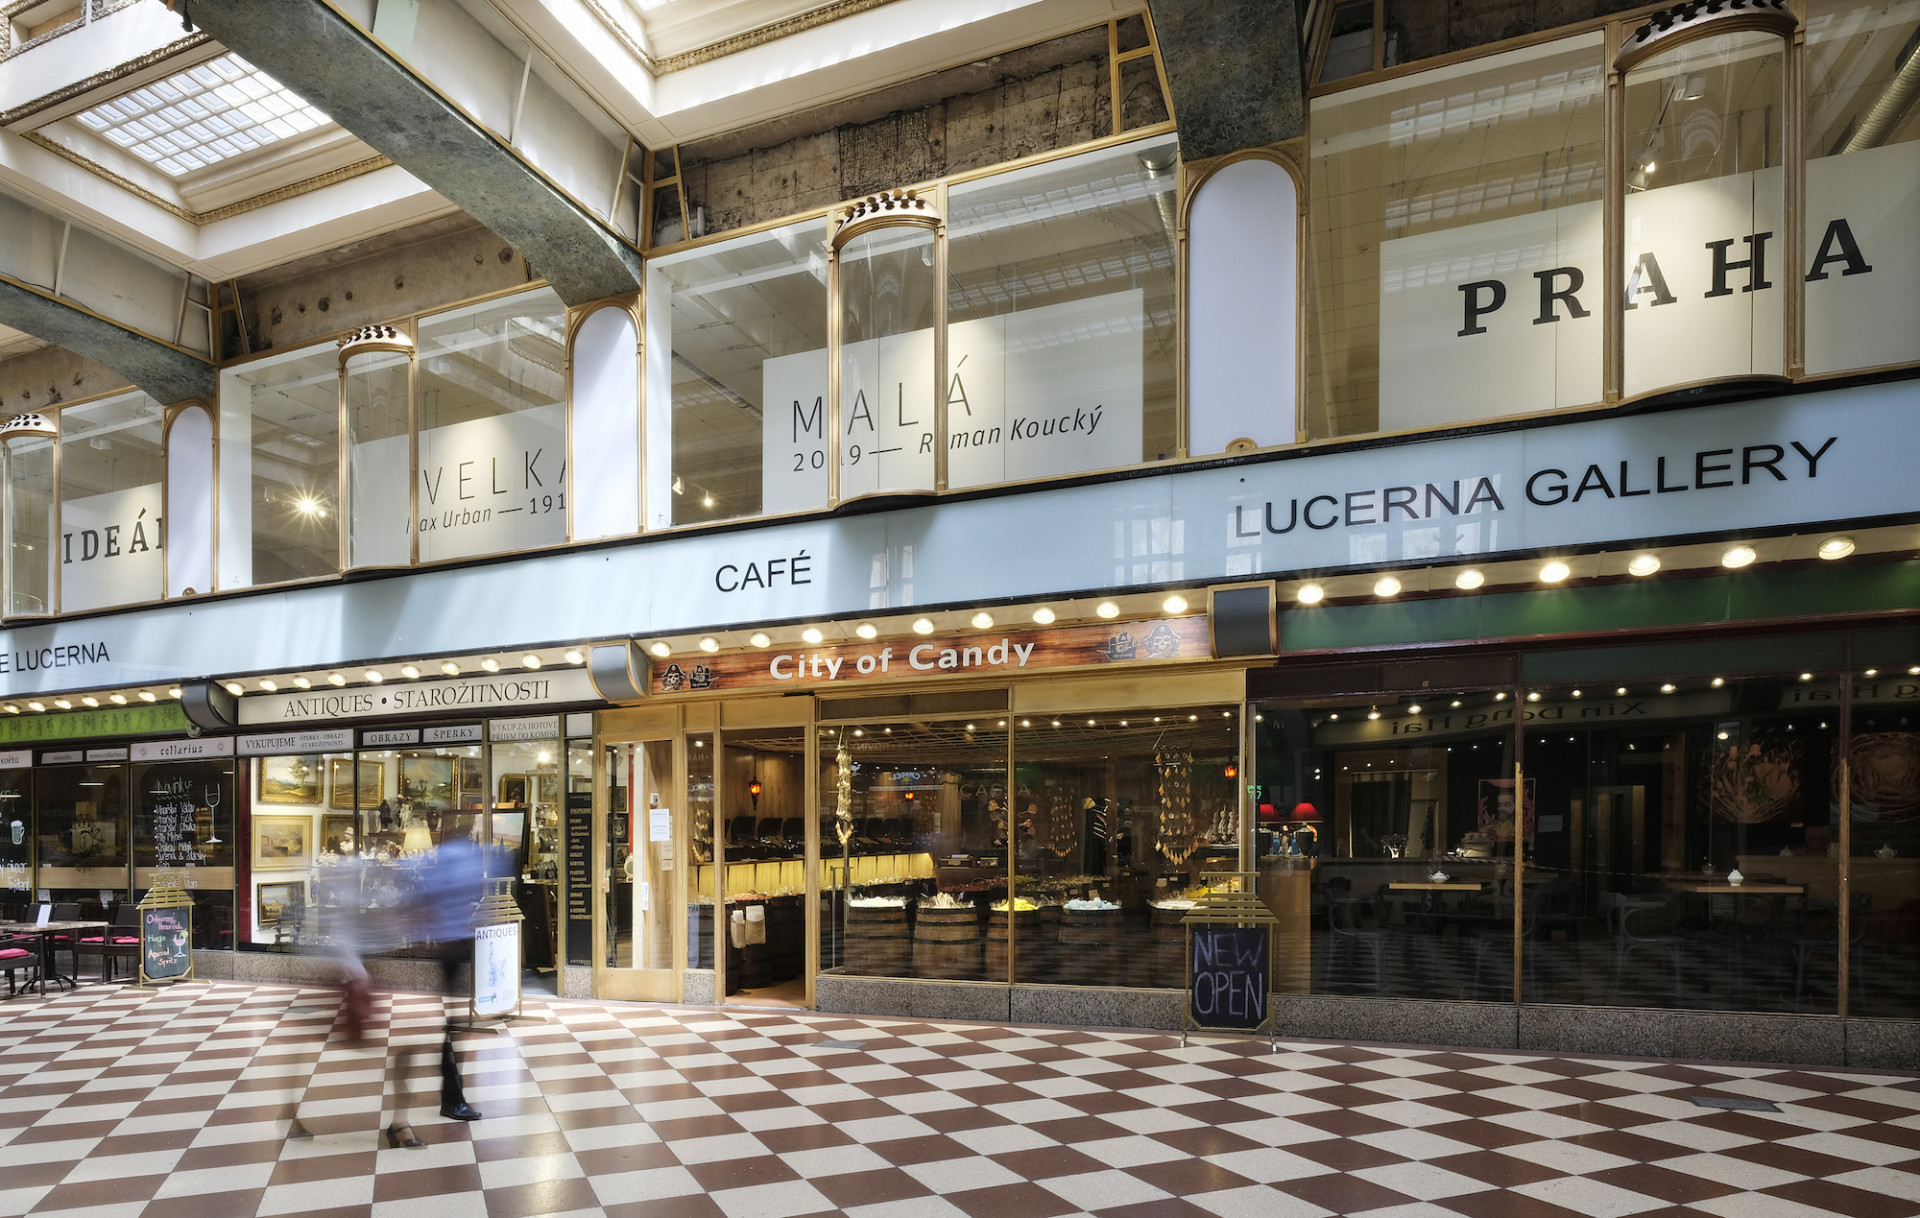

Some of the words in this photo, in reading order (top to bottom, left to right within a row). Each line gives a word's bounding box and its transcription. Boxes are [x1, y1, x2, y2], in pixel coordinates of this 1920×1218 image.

[1457, 218, 1873, 338] PRAHA
[793, 354, 973, 443] MALÁ
[793, 445, 861, 472] 209
[918, 427, 1000, 454] Rman
[1010, 404, 1103, 442] Koucký
[1235, 475, 1505, 539] LUCERNA
[1525, 437, 1838, 508] GALLERY
[406, 514, 437, 534] ax
[442, 507, 491, 529] Urban
[714, 549, 812, 592] CAFÉ
[16, 641, 110, 672] LUCERNA
[769, 653, 843, 680] City
[856, 647, 893, 674] of
[908, 636, 1035, 672] Candy
[283, 694, 374, 718] ANTIQUES
[393, 680, 551, 710] STAROŽITNOSTI
[160, 745, 203, 756] cellarius
[245, 737, 296, 749] VYKUPUJEME
[370, 732, 412, 743] OBRAZY
[433, 727, 474, 739] ŠPERKY
[476, 926, 517, 940] ANTIQUES
[1194, 931, 1264, 973] NEW
[1193, 971, 1262, 1020] OPEN
